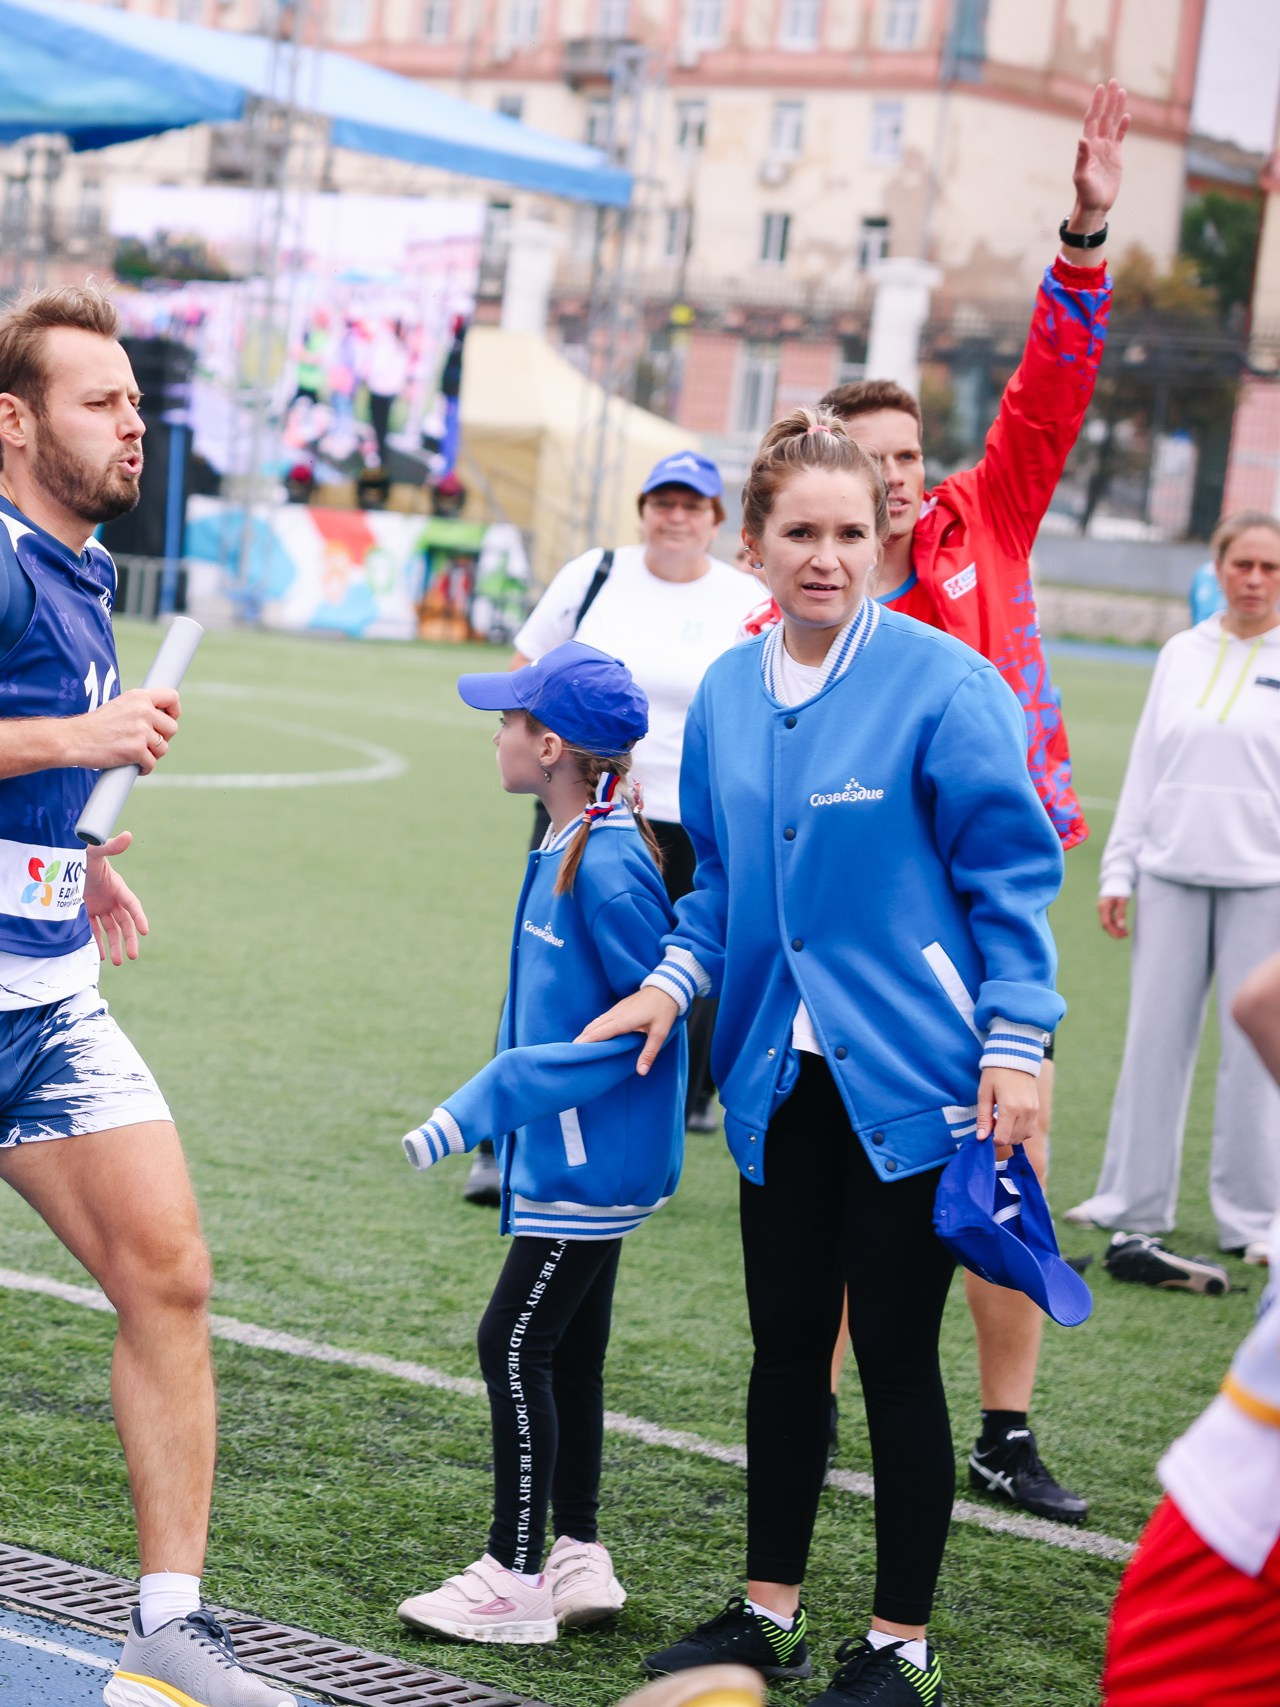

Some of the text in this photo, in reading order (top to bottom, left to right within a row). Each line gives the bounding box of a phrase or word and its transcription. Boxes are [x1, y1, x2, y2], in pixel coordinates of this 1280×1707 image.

[809, 786, 885, 807] Созвездие
[539, 1261, 557, 1280] BE
[526, 1280, 547, 1309] SHY
[509, 1311, 533, 1349] WILD
[508, 1351, 525, 1401] HEART
[515, 1403, 532, 1451] DON'T
[520, 1454, 532, 1473] BE
[519, 1475, 532, 1504] SHY
[517, 1507, 531, 1544] WILD
